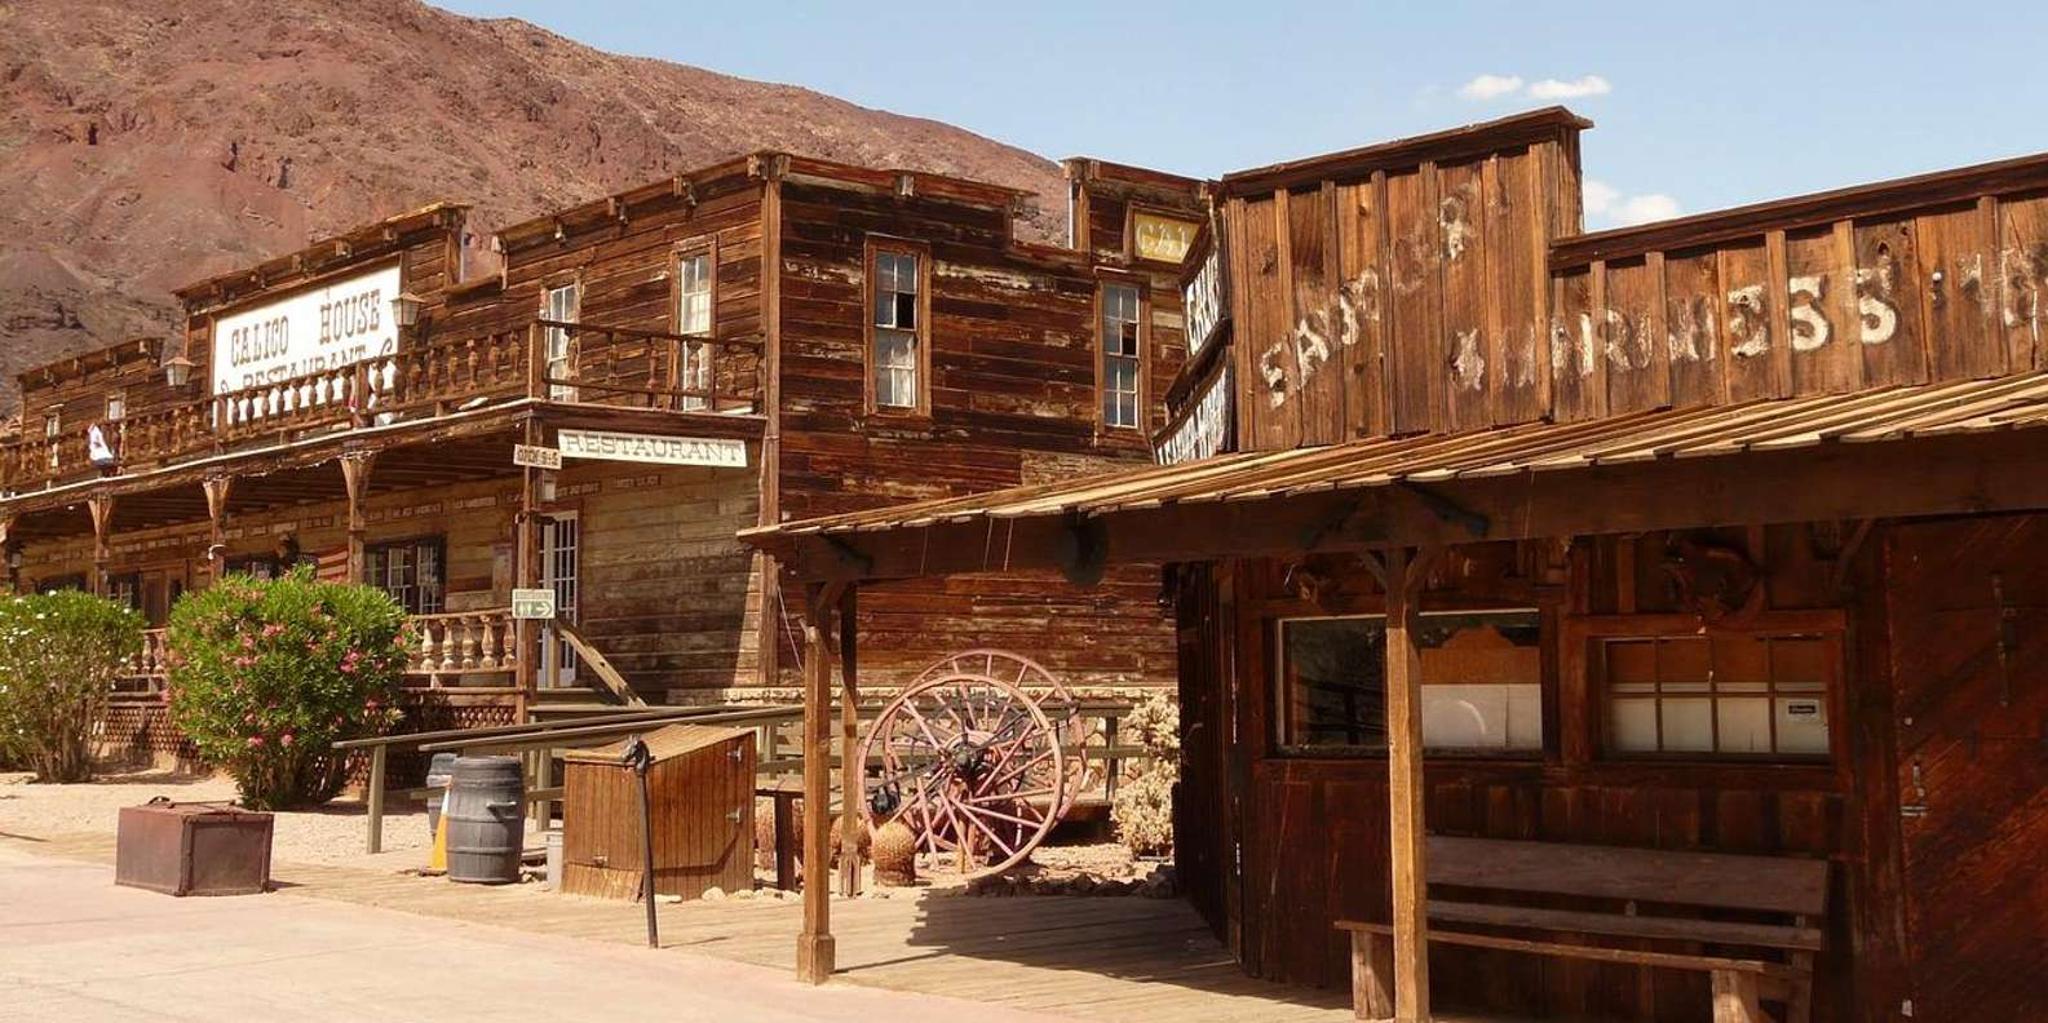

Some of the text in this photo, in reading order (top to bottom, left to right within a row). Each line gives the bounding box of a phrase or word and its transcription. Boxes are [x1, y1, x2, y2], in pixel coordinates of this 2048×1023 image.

[231, 289, 381, 368] CALICO HOUSE
[563, 433, 742, 462] RESTAURANT
